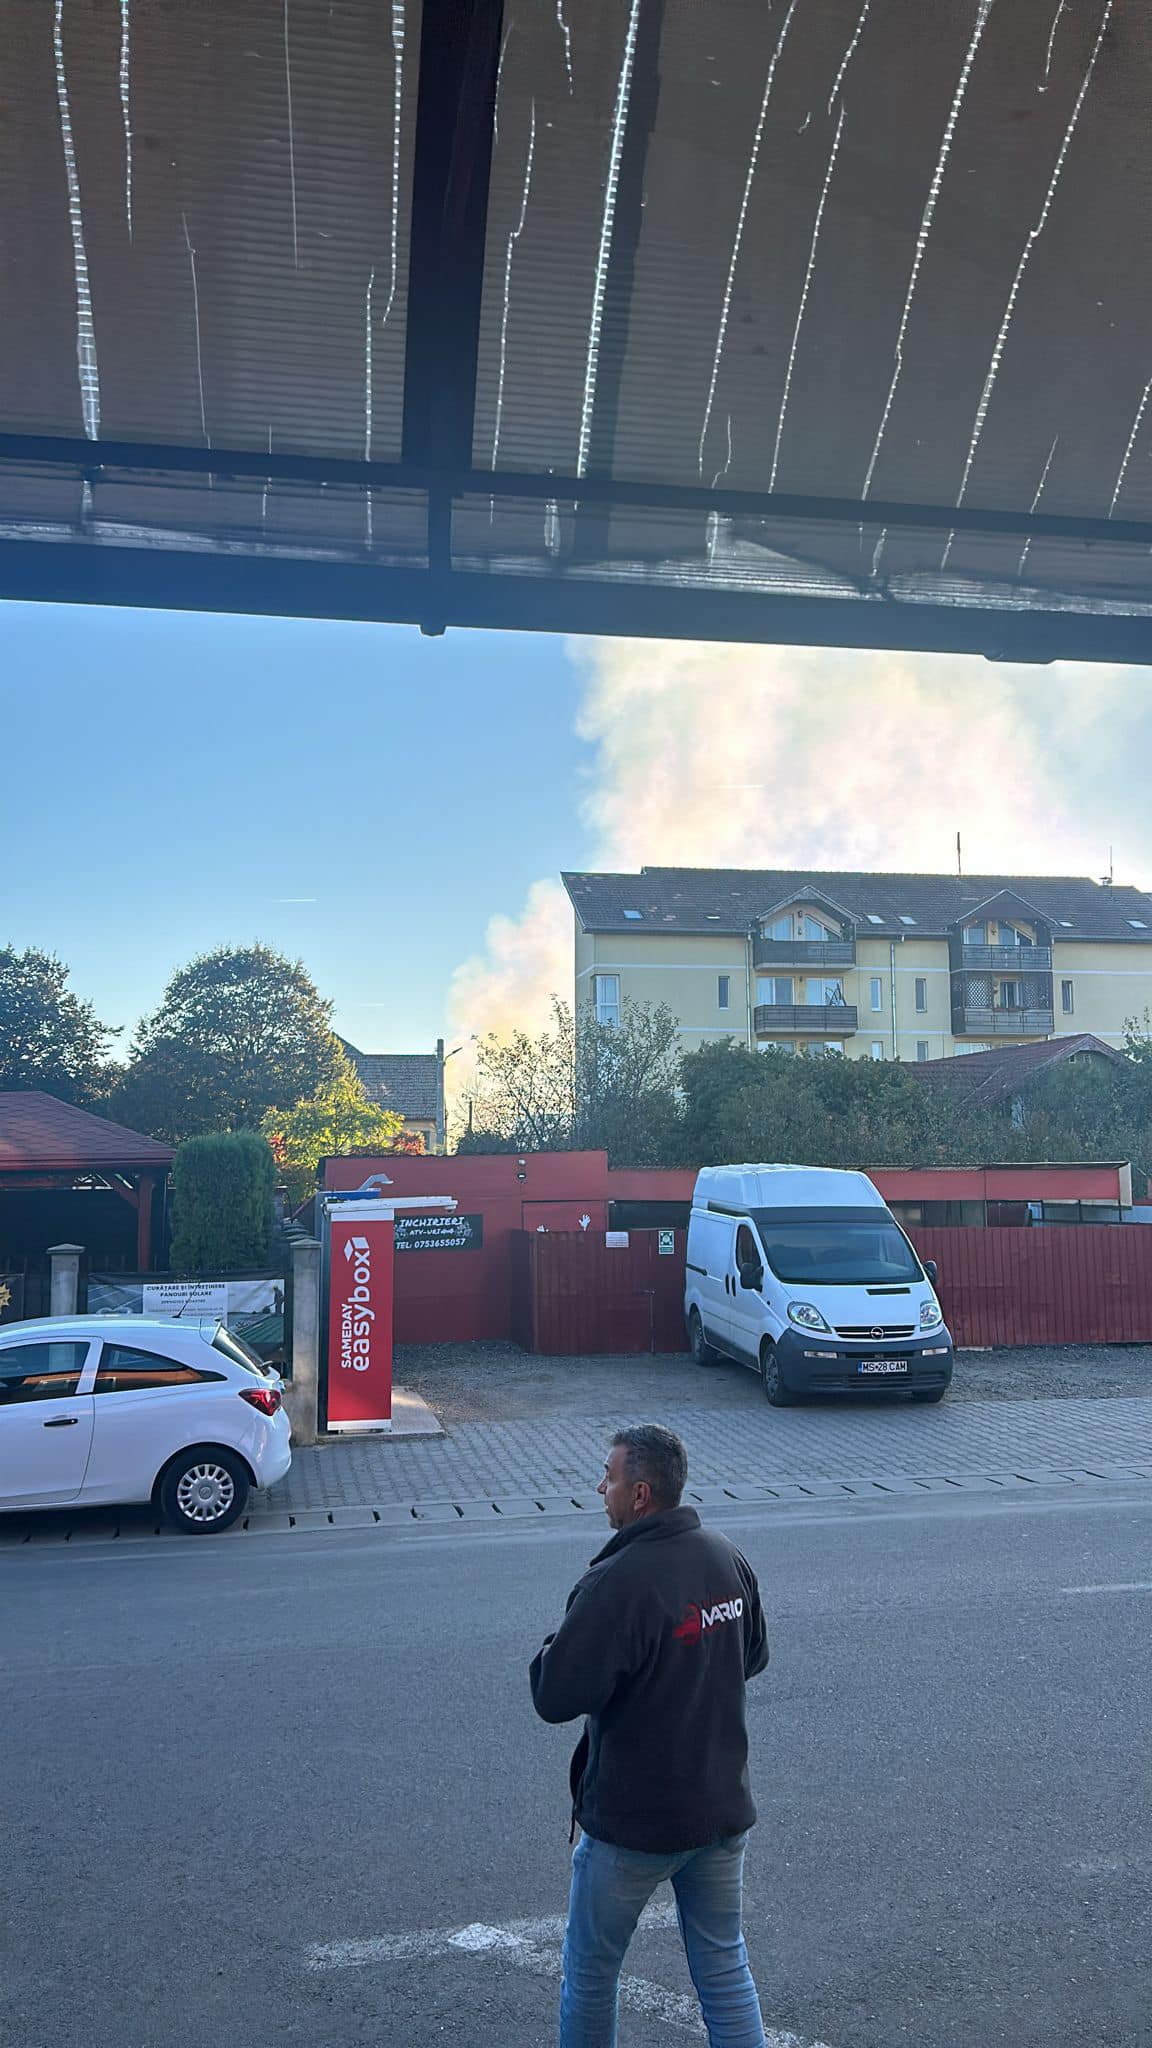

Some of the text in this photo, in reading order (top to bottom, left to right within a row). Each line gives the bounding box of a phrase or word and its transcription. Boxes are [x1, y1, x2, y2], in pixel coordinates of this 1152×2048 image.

[414, 1238, 466, 1248] 0753655057
[348, 1250, 375, 1371] easybox
[341, 1303, 352, 1369] SAMEDAY
[863, 1361, 906, 1371] MS 28 CAM
